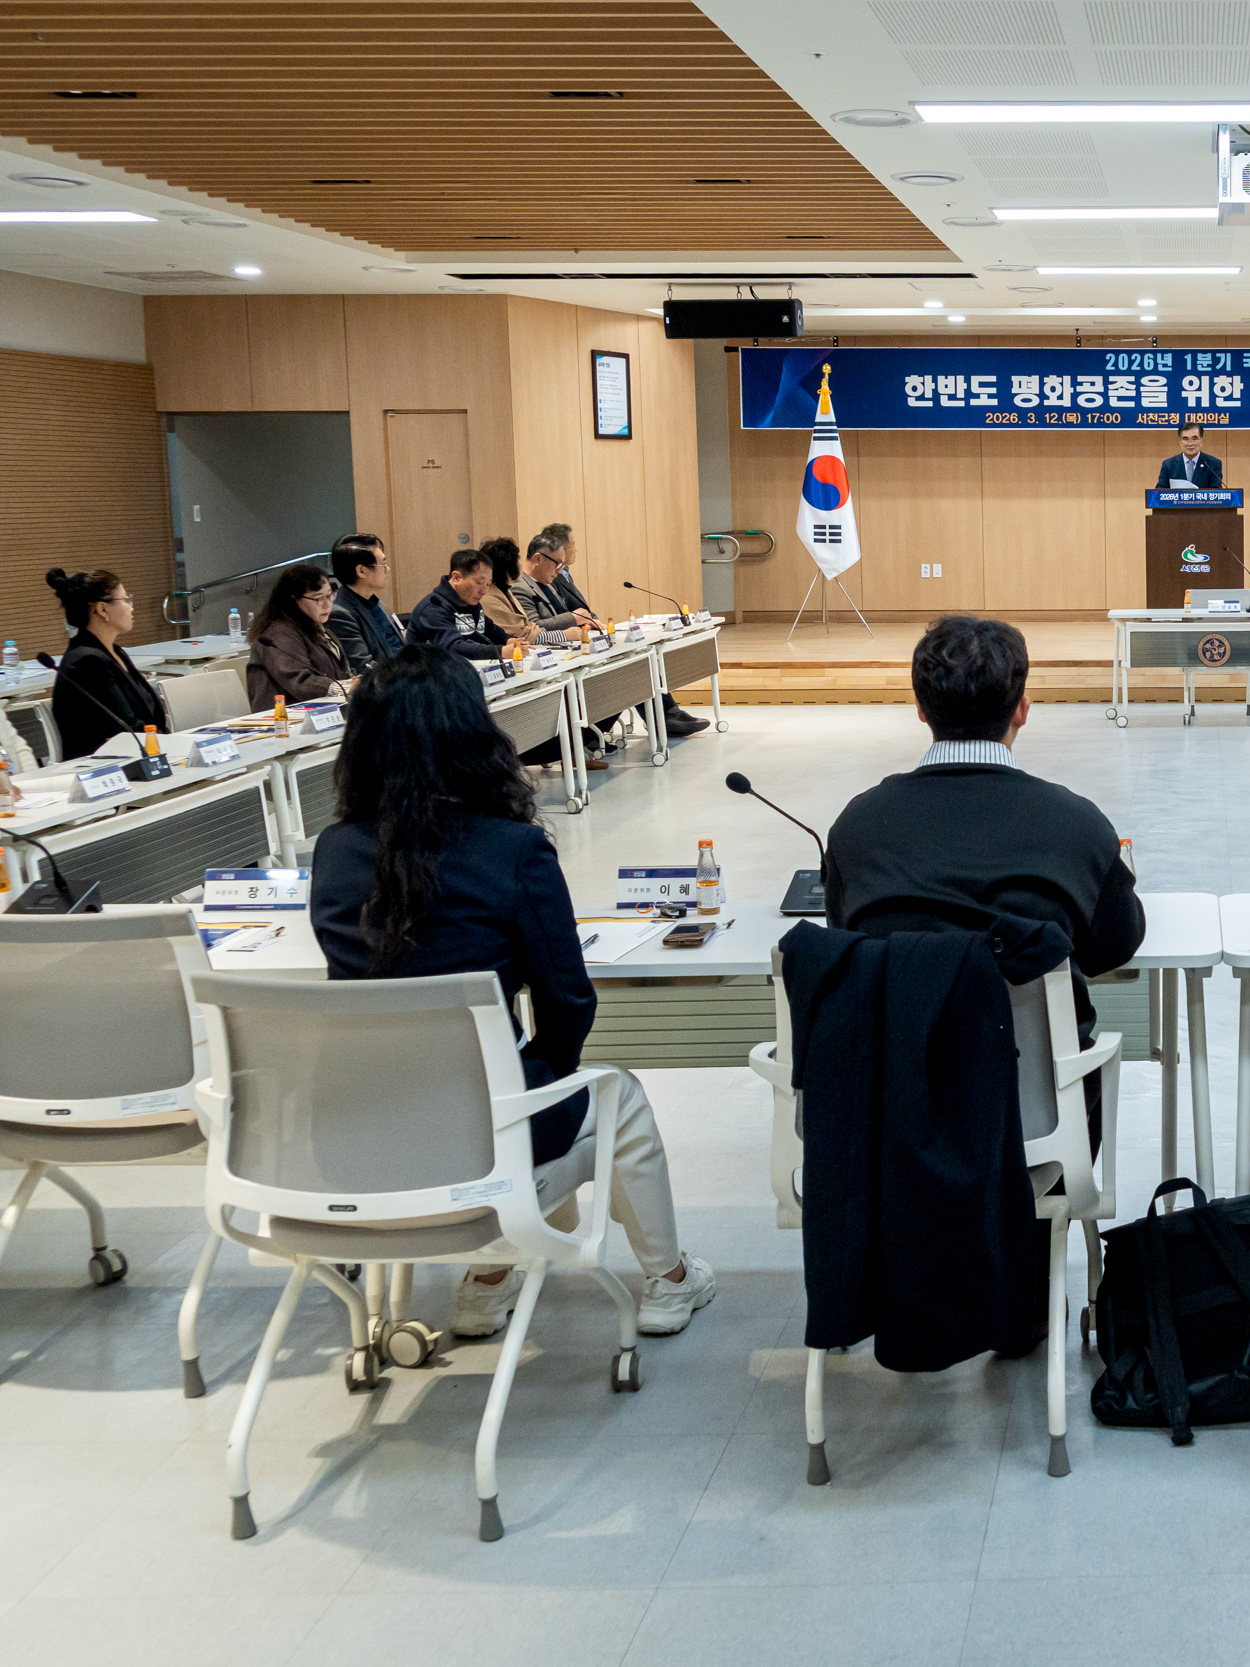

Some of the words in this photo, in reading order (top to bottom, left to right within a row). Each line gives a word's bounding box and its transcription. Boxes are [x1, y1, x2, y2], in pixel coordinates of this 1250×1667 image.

[1105, 352, 1173, 371] 2026년
[1184, 352, 1232, 371] 1분기
[904, 375, 998, 407] 한반도
[1011, 375, 1168, 408] 평화공존을
[1181, 375, 1244, 408] 위한
[985, 412, 1022, 424] 2026.
[1027, 412, 1039, 424] 3.
[1044, 412, 1081, 425] 12.(목)
[1086, 412, 1121, 424] 17:00
[1136, 412, 1180, 425] 서천군청
[1185, 412, 1230, 425] 대회의실
[1159, 492, 1179, 500] 2026년
[1196, 492, 1208, 500] 국내
[247, 886, 298, 899] 장기수
[659, 883, 690, 896] 이혜
